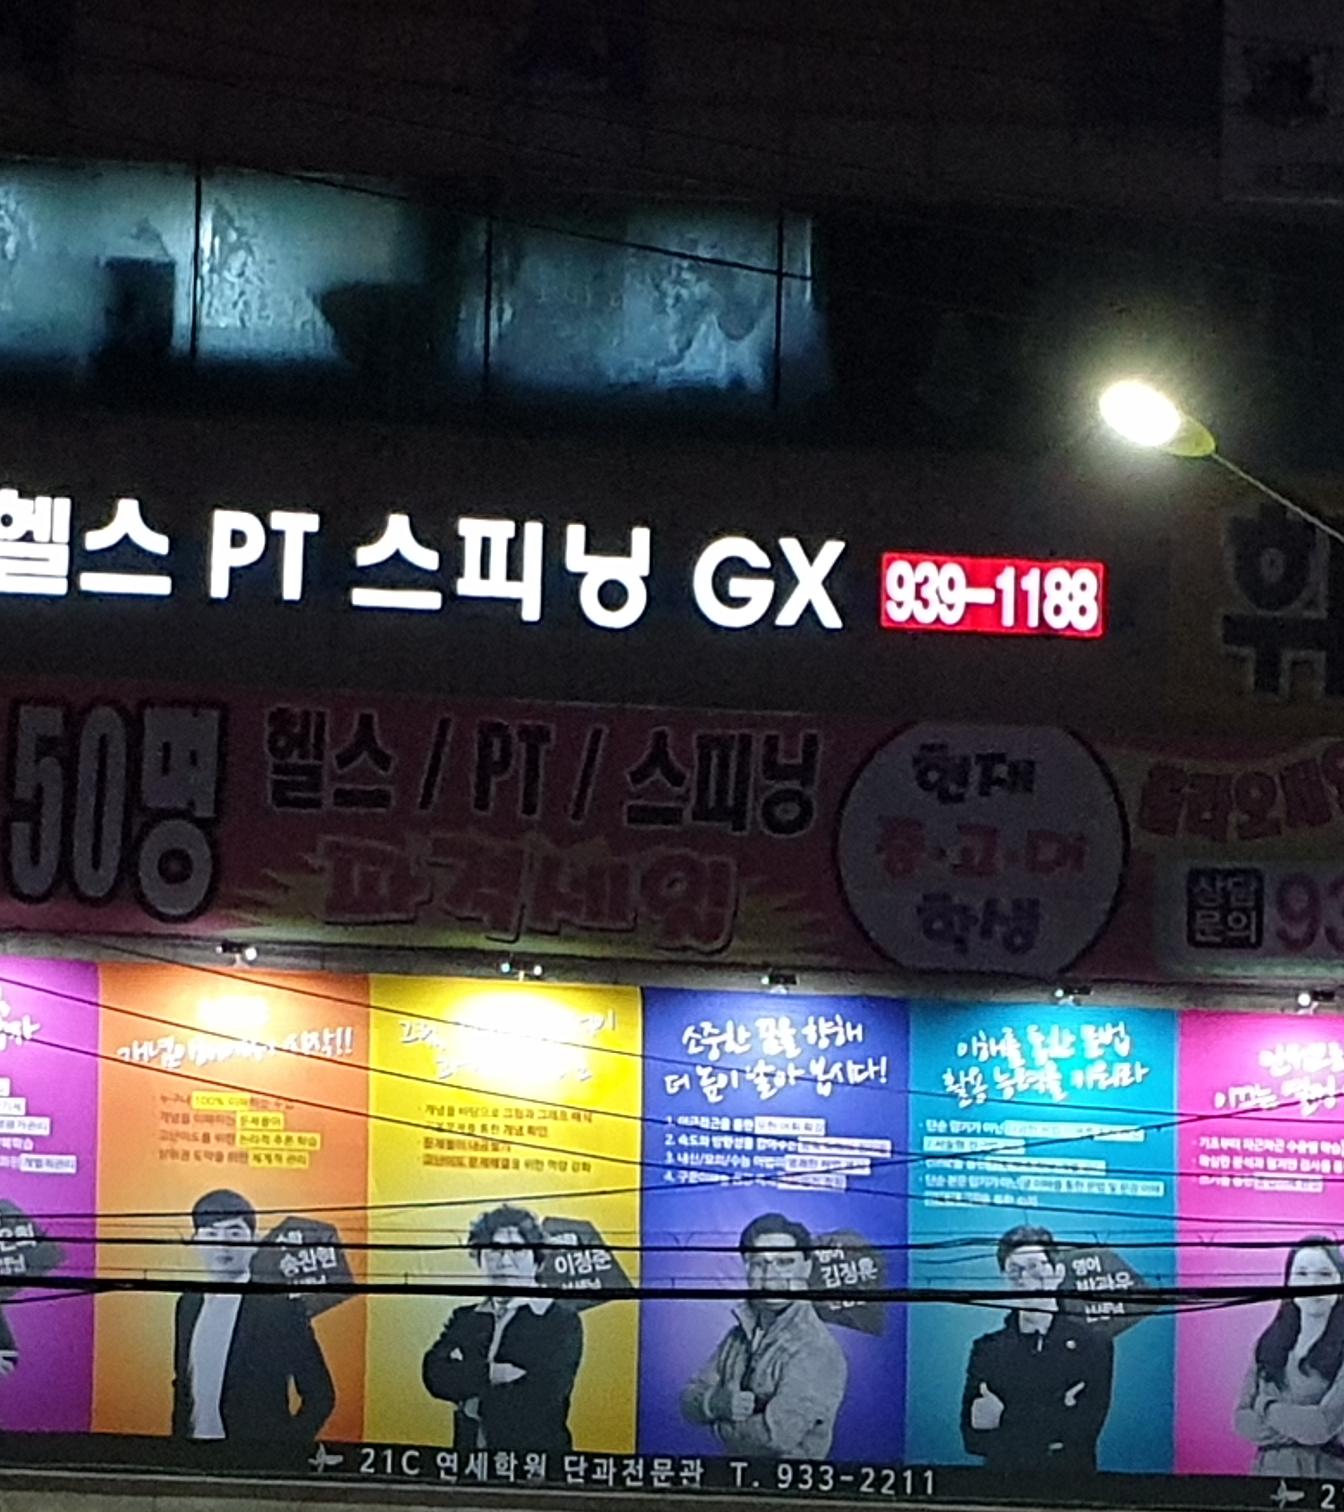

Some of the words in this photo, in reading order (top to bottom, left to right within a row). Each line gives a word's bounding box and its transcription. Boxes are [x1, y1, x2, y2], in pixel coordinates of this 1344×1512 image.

[209, 511, 321, 603] PT
[353, 514, 652, 630] 스피닝
[692, 537, 846, 631] GX
[884, 557, 1103, 634] 939-1188
[268, 706, 393, 810] 헬스
[473, 719, 552, 818] PT
[625, 728, 819, 838] 스피닝
[913, 742, 1036, 805] 현재
[4, 698, 227, 922] 50명
[913, 892, 1044, 957] 학생
[682, 1020, 752, 1061] 소중한
[802, 1013, 864, 1049] 향해
[664, 1073, 690, 1095] 더
[1072, 1255, 1102, 1277] 영어
[359, 1446, 421, 1476] 21C
[436, 1450, 547, 1483] 연세학원
[562, 1455, 705, 1489] 단과전문관
[730, 1463, 760, 1488] T.
[777, 1464, 936, 1496] 933-2211
